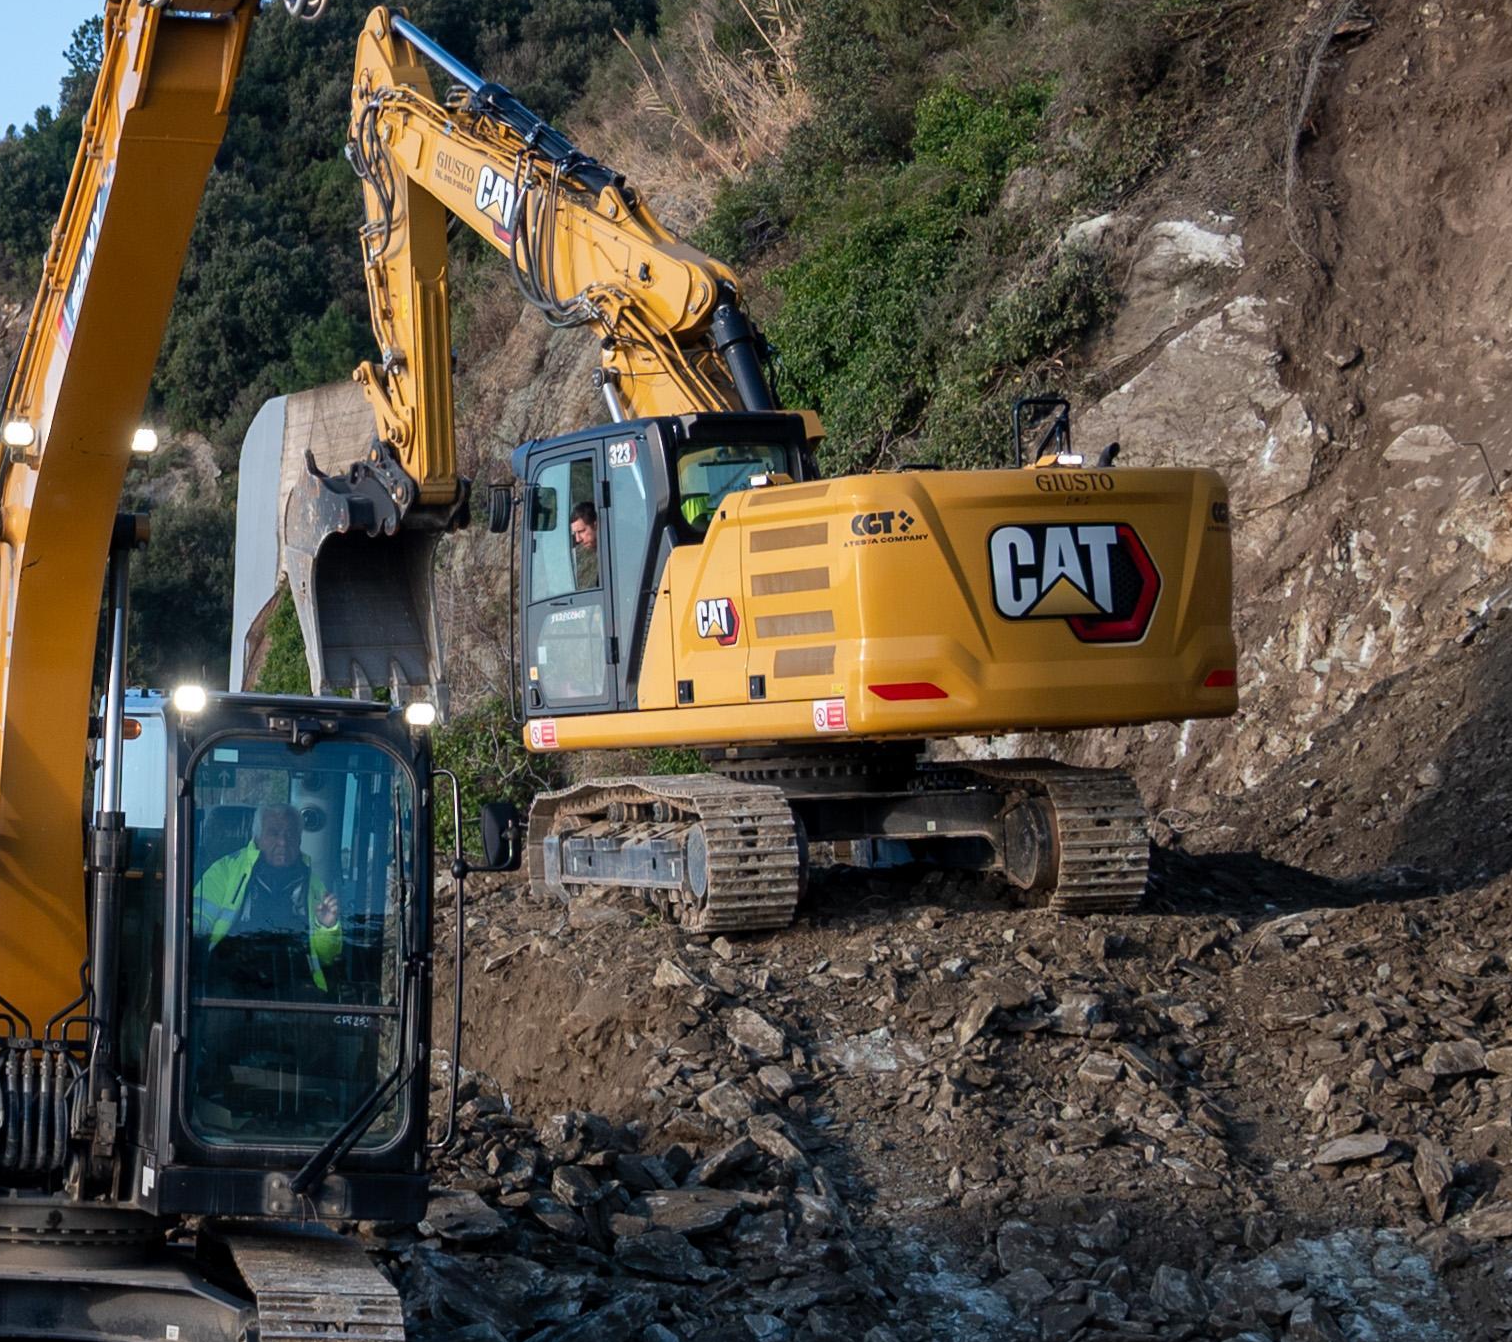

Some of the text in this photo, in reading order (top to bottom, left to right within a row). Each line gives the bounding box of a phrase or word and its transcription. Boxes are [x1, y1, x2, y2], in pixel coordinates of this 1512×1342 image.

[437, 150, 475, 184] GIUSTO
[476, 165, 515, 230] CAT
[609, 442, 631, 465] 323
[1035, 473, 1114, 492] GIUSTO
[851, 511, 895, 536] CGT
[880, 534, 929, 544] COMPANY
[990, 525, 1118, 617] CAT
[696, 598, 729, 638] CAT
